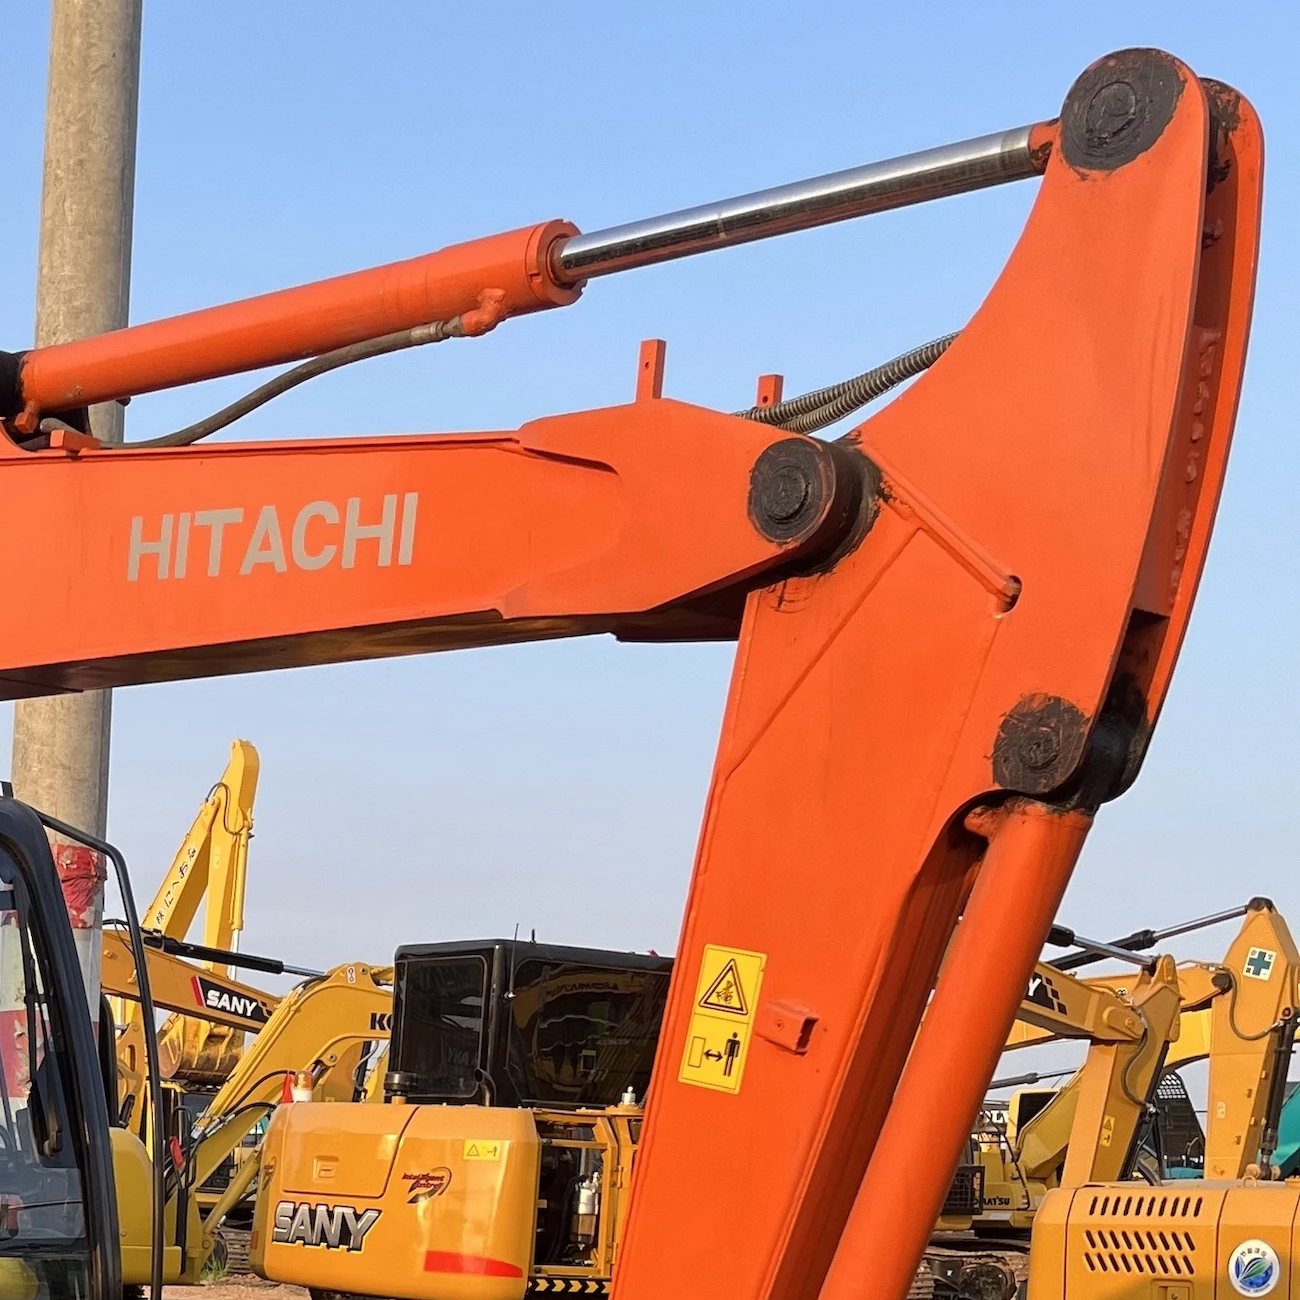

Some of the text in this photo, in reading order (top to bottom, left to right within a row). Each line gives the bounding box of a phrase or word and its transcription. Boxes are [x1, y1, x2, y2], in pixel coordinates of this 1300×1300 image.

[126, 492, 418, 582] HITACHI
[206, 989, 258, 1017] SANY
[273, 1201, 382, 1252] SANY
